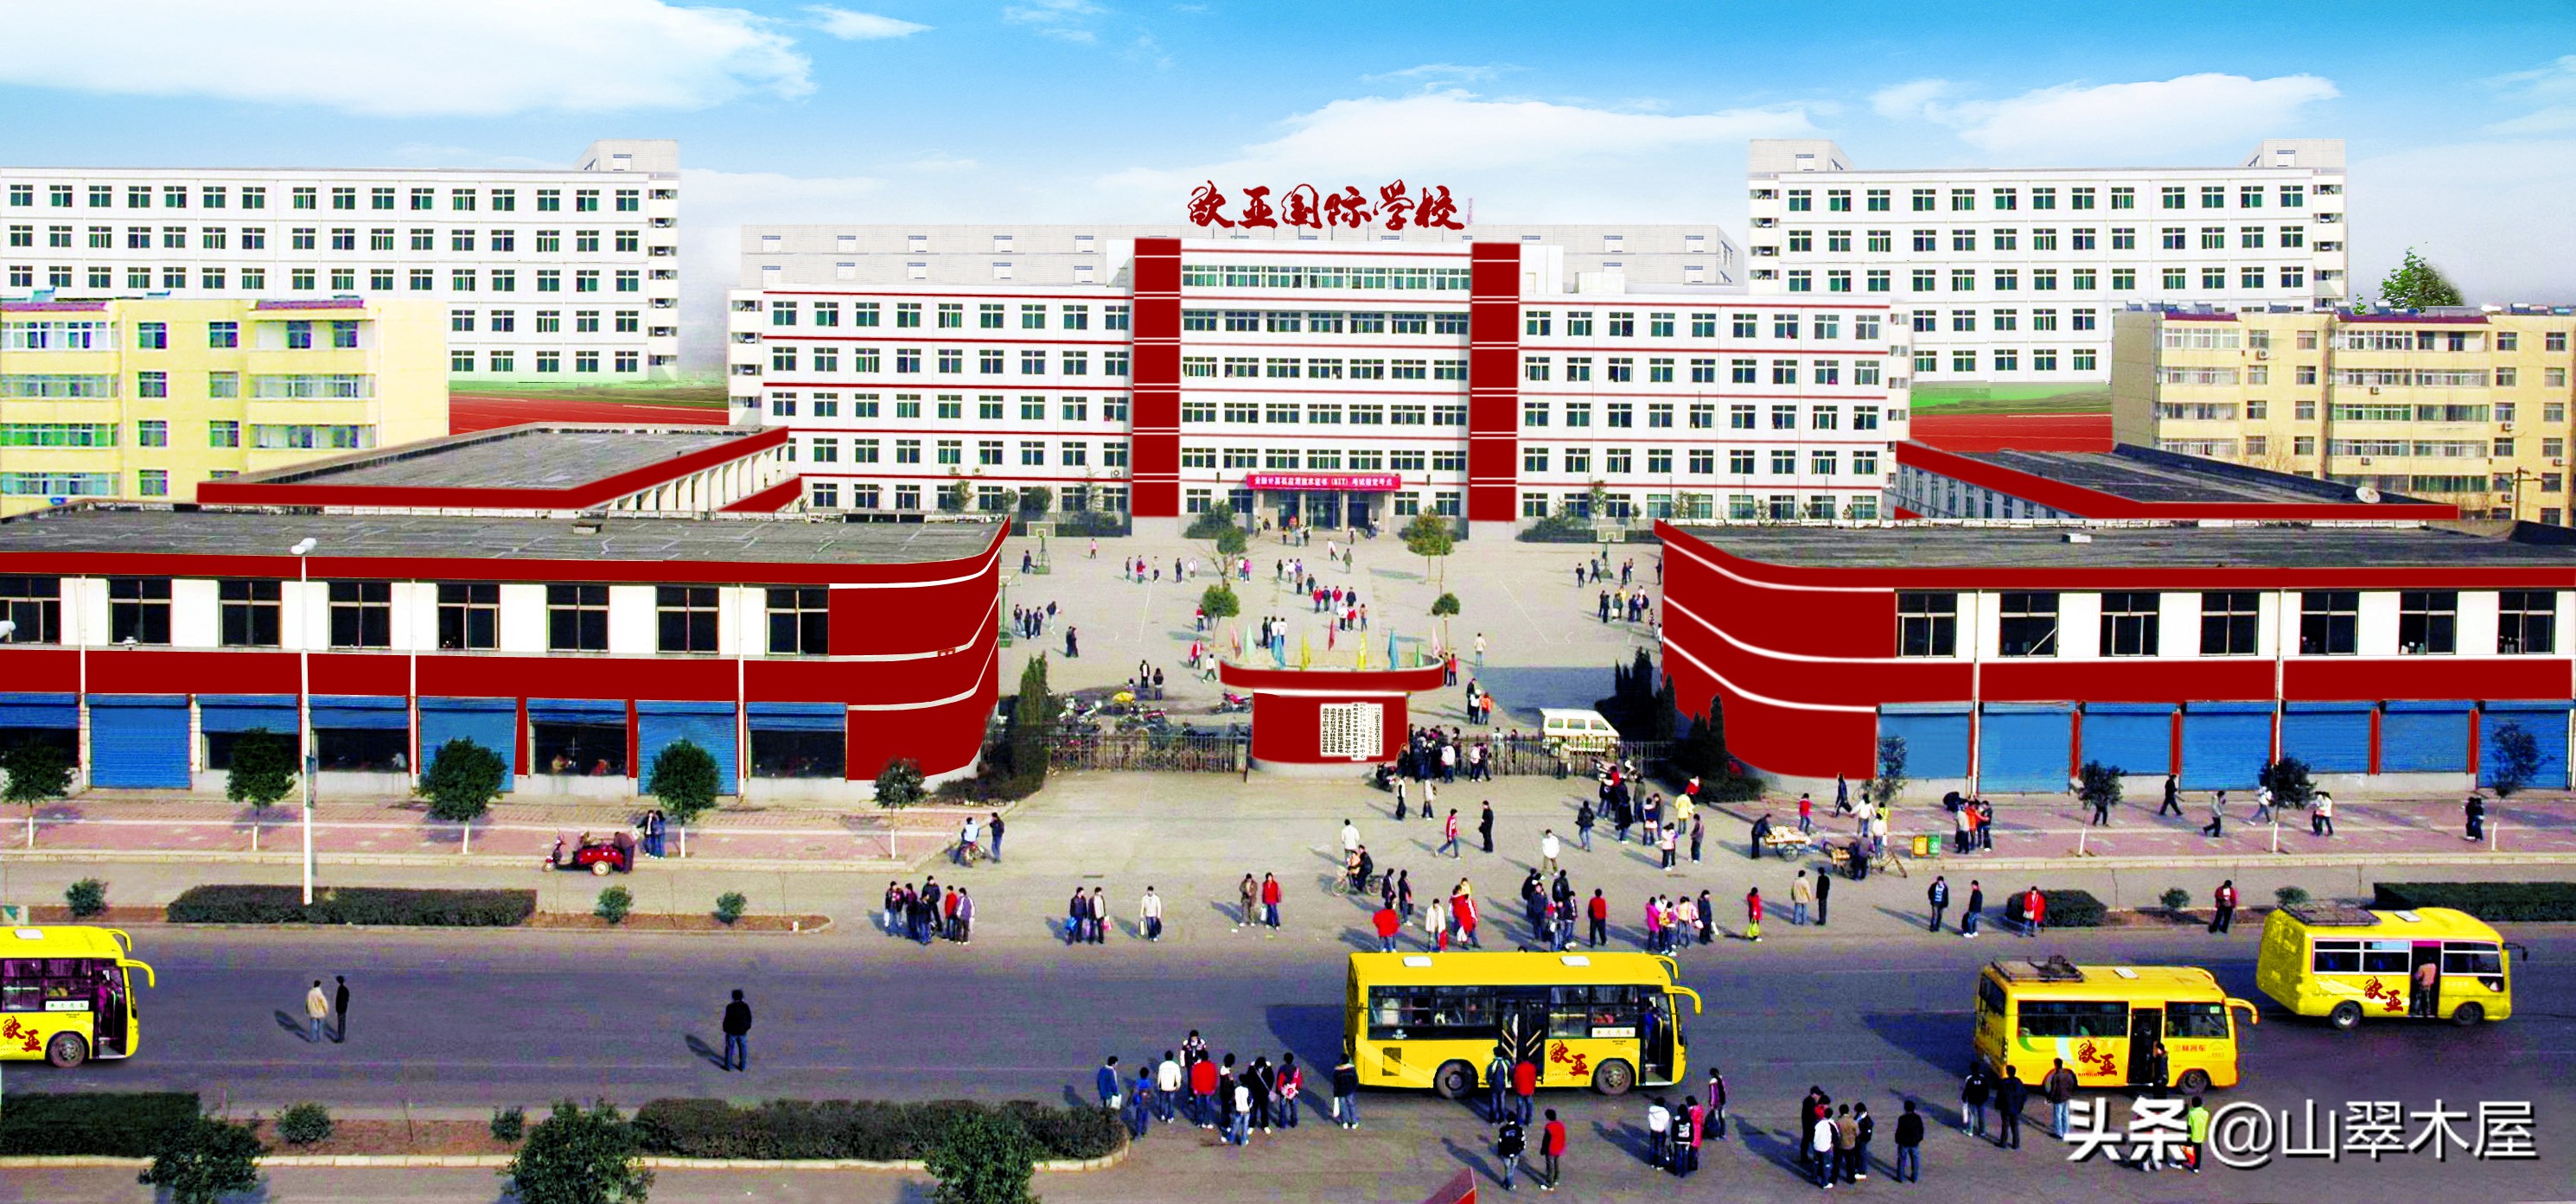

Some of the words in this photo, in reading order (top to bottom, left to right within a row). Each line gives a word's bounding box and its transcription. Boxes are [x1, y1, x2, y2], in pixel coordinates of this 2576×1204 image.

[1188, 180, 1465, 231] 欧亚国际学校
[2364, 976, 2404, 1013] 欧亚
[3, 1015, 42, 1053] 欧亚
[1550, 1039, 1590, 1077] 欧亚
[2078, 1039, 2118, 1077] 欧亚
